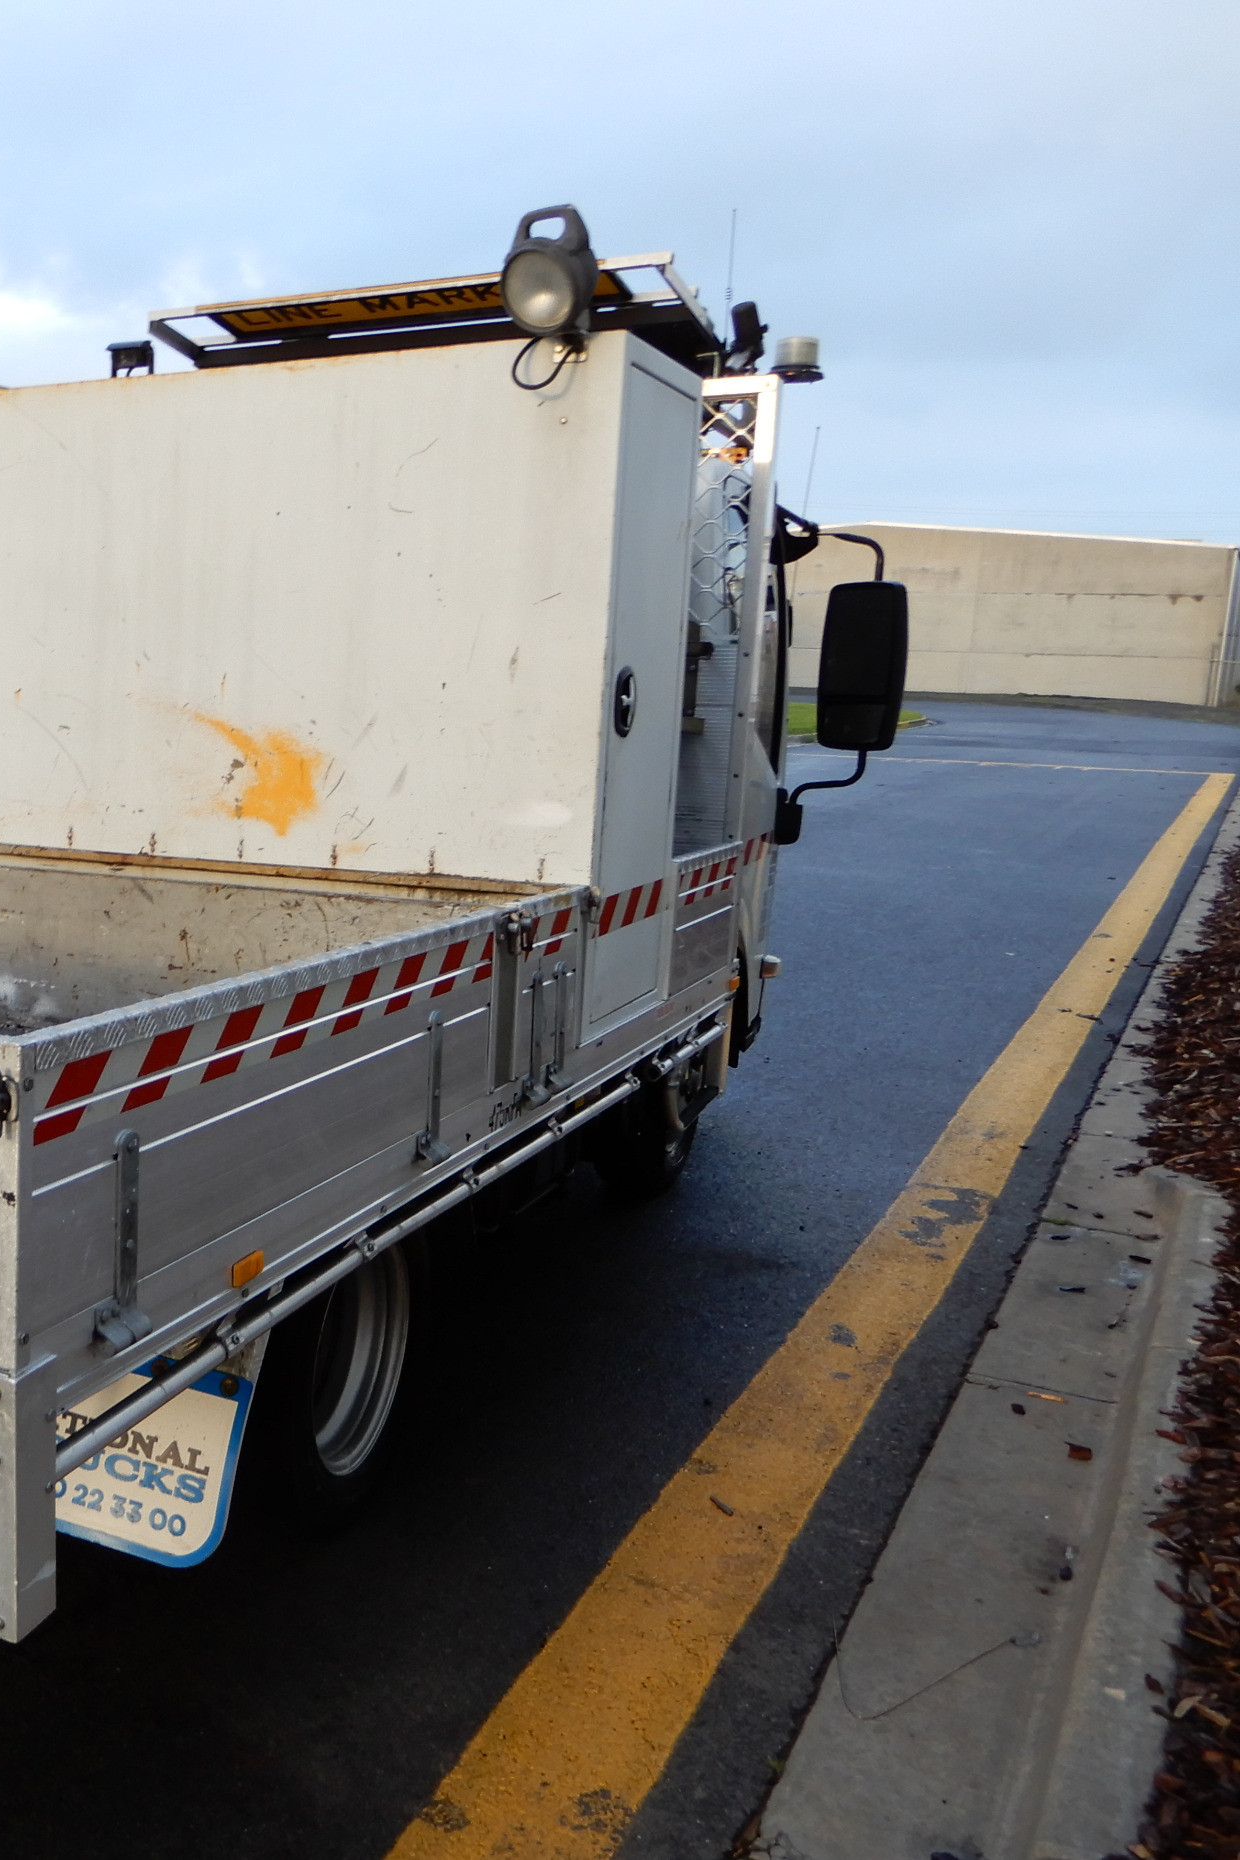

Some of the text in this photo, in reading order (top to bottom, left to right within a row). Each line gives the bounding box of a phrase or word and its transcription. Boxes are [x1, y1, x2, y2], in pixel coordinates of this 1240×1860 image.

[236, 283, 501, 326] LINE MARK
[77, 1450, 208, 1503] UCKS
[71, 1484, 104, 1512] 22
[109, 1494, 144, 1524] 33
[149, 1508, 187, 1537] 00
